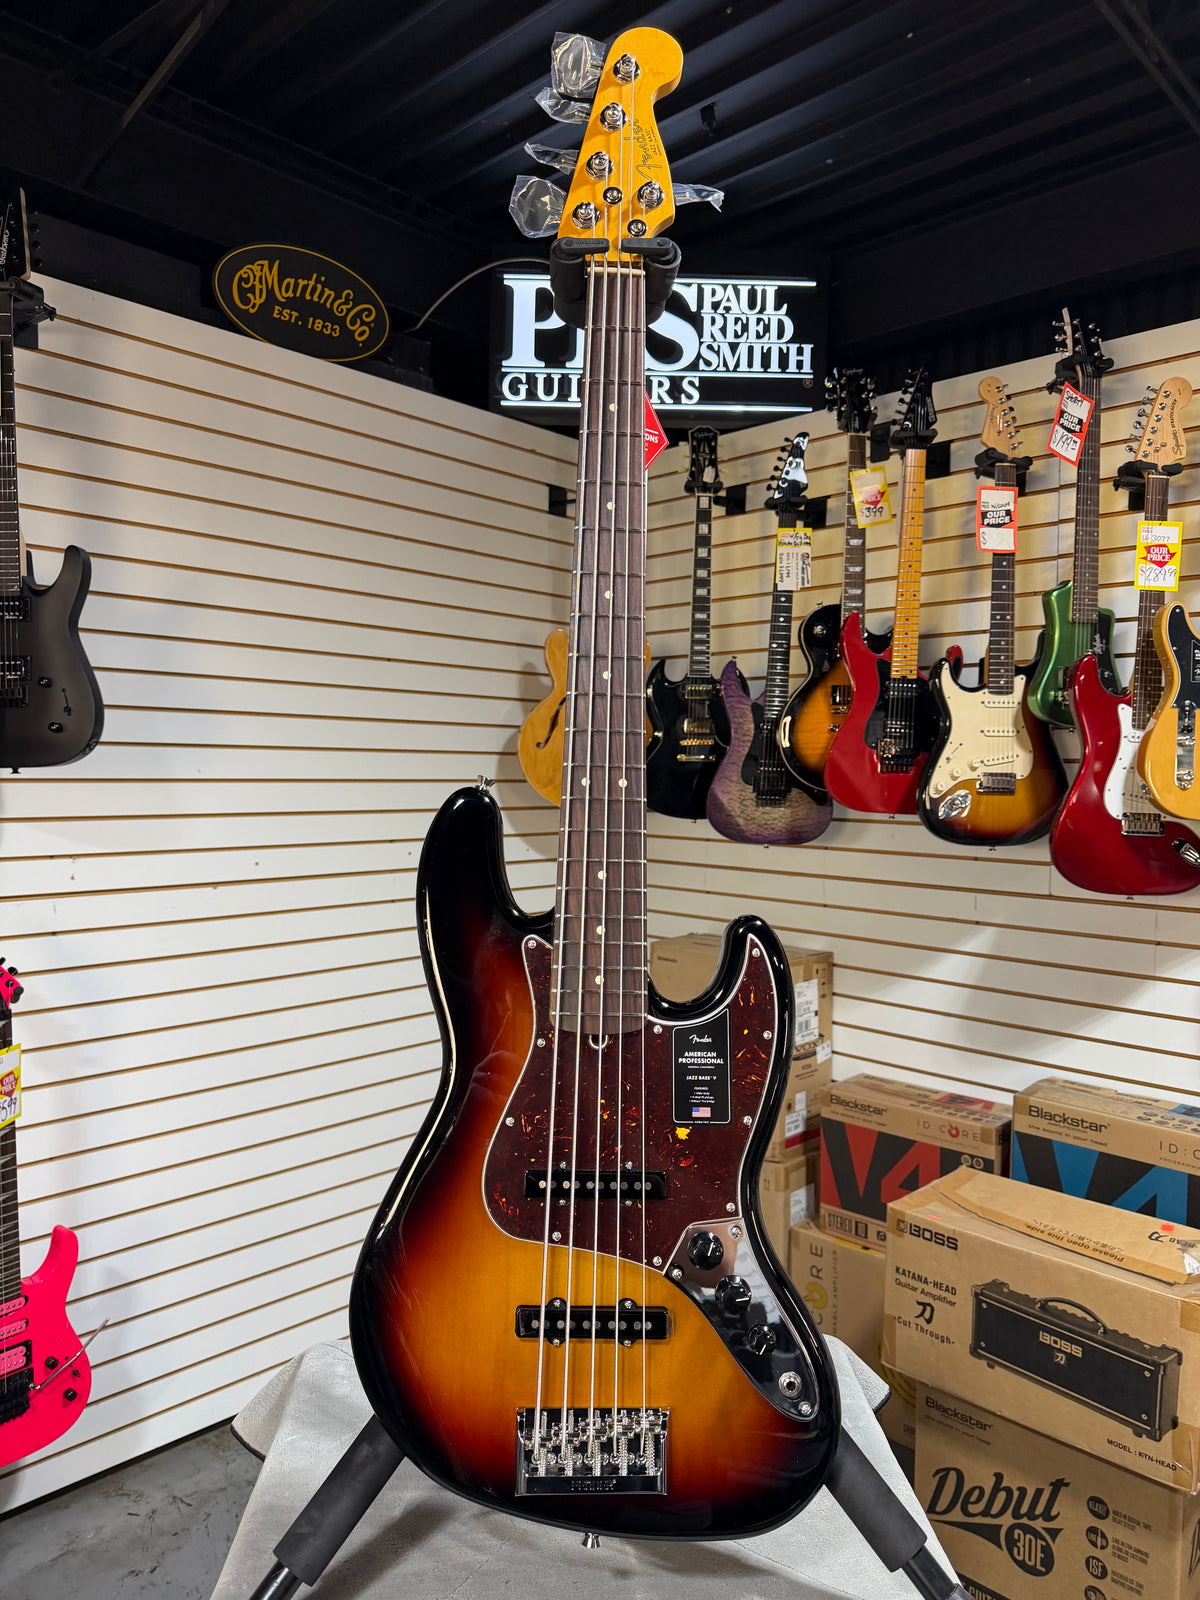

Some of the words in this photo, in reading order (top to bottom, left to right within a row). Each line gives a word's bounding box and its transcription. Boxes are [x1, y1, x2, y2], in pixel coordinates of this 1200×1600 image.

[700, 283, 787, 315] PAUL
[272, 305, 302, 326] EST.
[307, 317, 341, 338] 1833
[700, 313, 794, 343] REED
[700, 341, 814, 373] SMITH
[501, 372, 700, 404] GUIRS
[1059, 418, 1081, 432] PRICE
[1062, 412, 1079, 424] OUR
[983, 516, 1011, 526] PRICE
[987, 510, 1006, 519] OUR
[1147, 554, 1170, 562] PRICE
[1150, 546, 1168, 554] OUR
[689, 1034, 713, 1044] Fender
[678, 1057, 725, 1065] PROFESSIONAL
[1, 1081, 16, 1095] PRICE
[3, 1073, 15, 1086] OUR
[0, 1097, 17, 1122] 599
[829, 1093, 887, 1116] Blackstar
[1028, 1104, 1110, 1134] Blackstar
[827, 1212, 853, 1234] STEREO
[909, 1222, 959, 1251] BOSS
[1047, 1230, 1064, 1242] this
[1067, 1237, 1090, 1250] open
[1093, 1247, 1125, 1263] Please
[895, 1265, 957, 1296] KATANA-HEAD
[894, 1277, 918, 1292] Guitar
[920, 1287, 957, 1308] Amplifier
[1039, 1330, 1083, 1358] BOSS
[925, 1396, 992, 1431] Blackstar
[1107, 1437, 1133, 1454] MODEL
[1138, 1451, 1178, 1472] KTN-HEAD
[927, 1466, 1070, 1523] Debut
[1013, 1528, 1047, 1573] 30E
[1089, 1557, 1104, 1578] ISF
